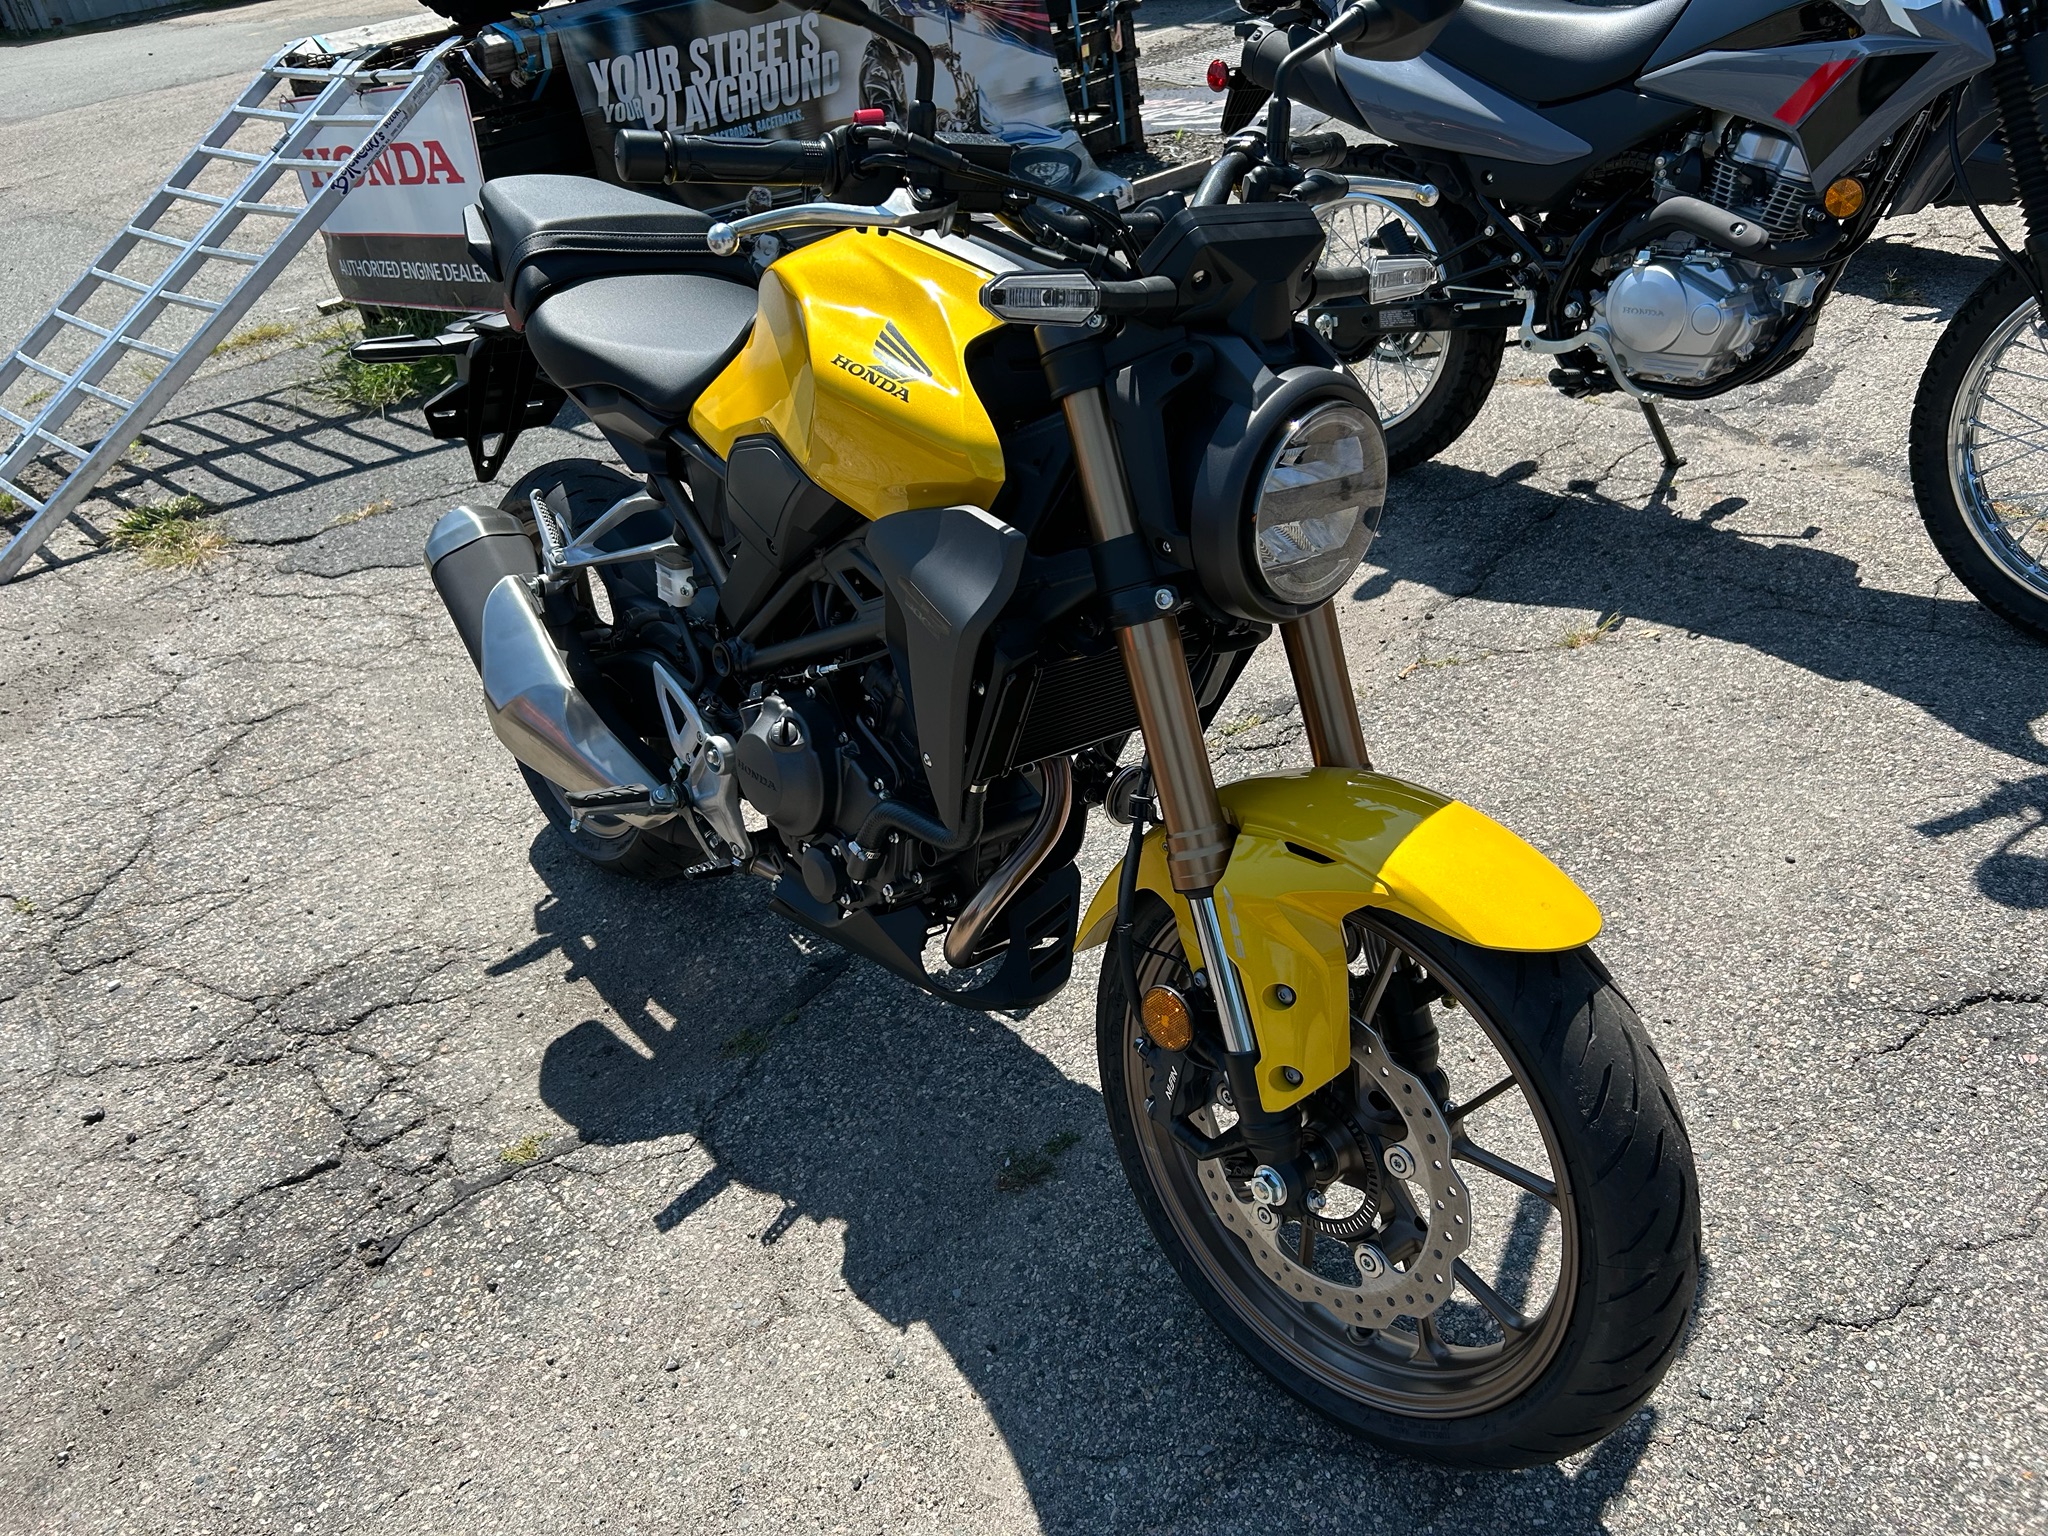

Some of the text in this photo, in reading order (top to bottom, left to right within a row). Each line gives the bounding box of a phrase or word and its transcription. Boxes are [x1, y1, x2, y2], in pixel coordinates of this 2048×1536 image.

[588, 12, 821, 107] YOUR STREETS
[602, 50, 840, 133] YOUR PLAYGROUND
[383, 108, 402, 129] SUZUKI
[339, 259, 400, 278] AUTHORIZED
[402, 261, 443, 281] ENGINE
[1622, 306, 1665, 317] HONDA
[830, 353, 910, 403] HONDA
[738, 759, 778, 792] HONDA
